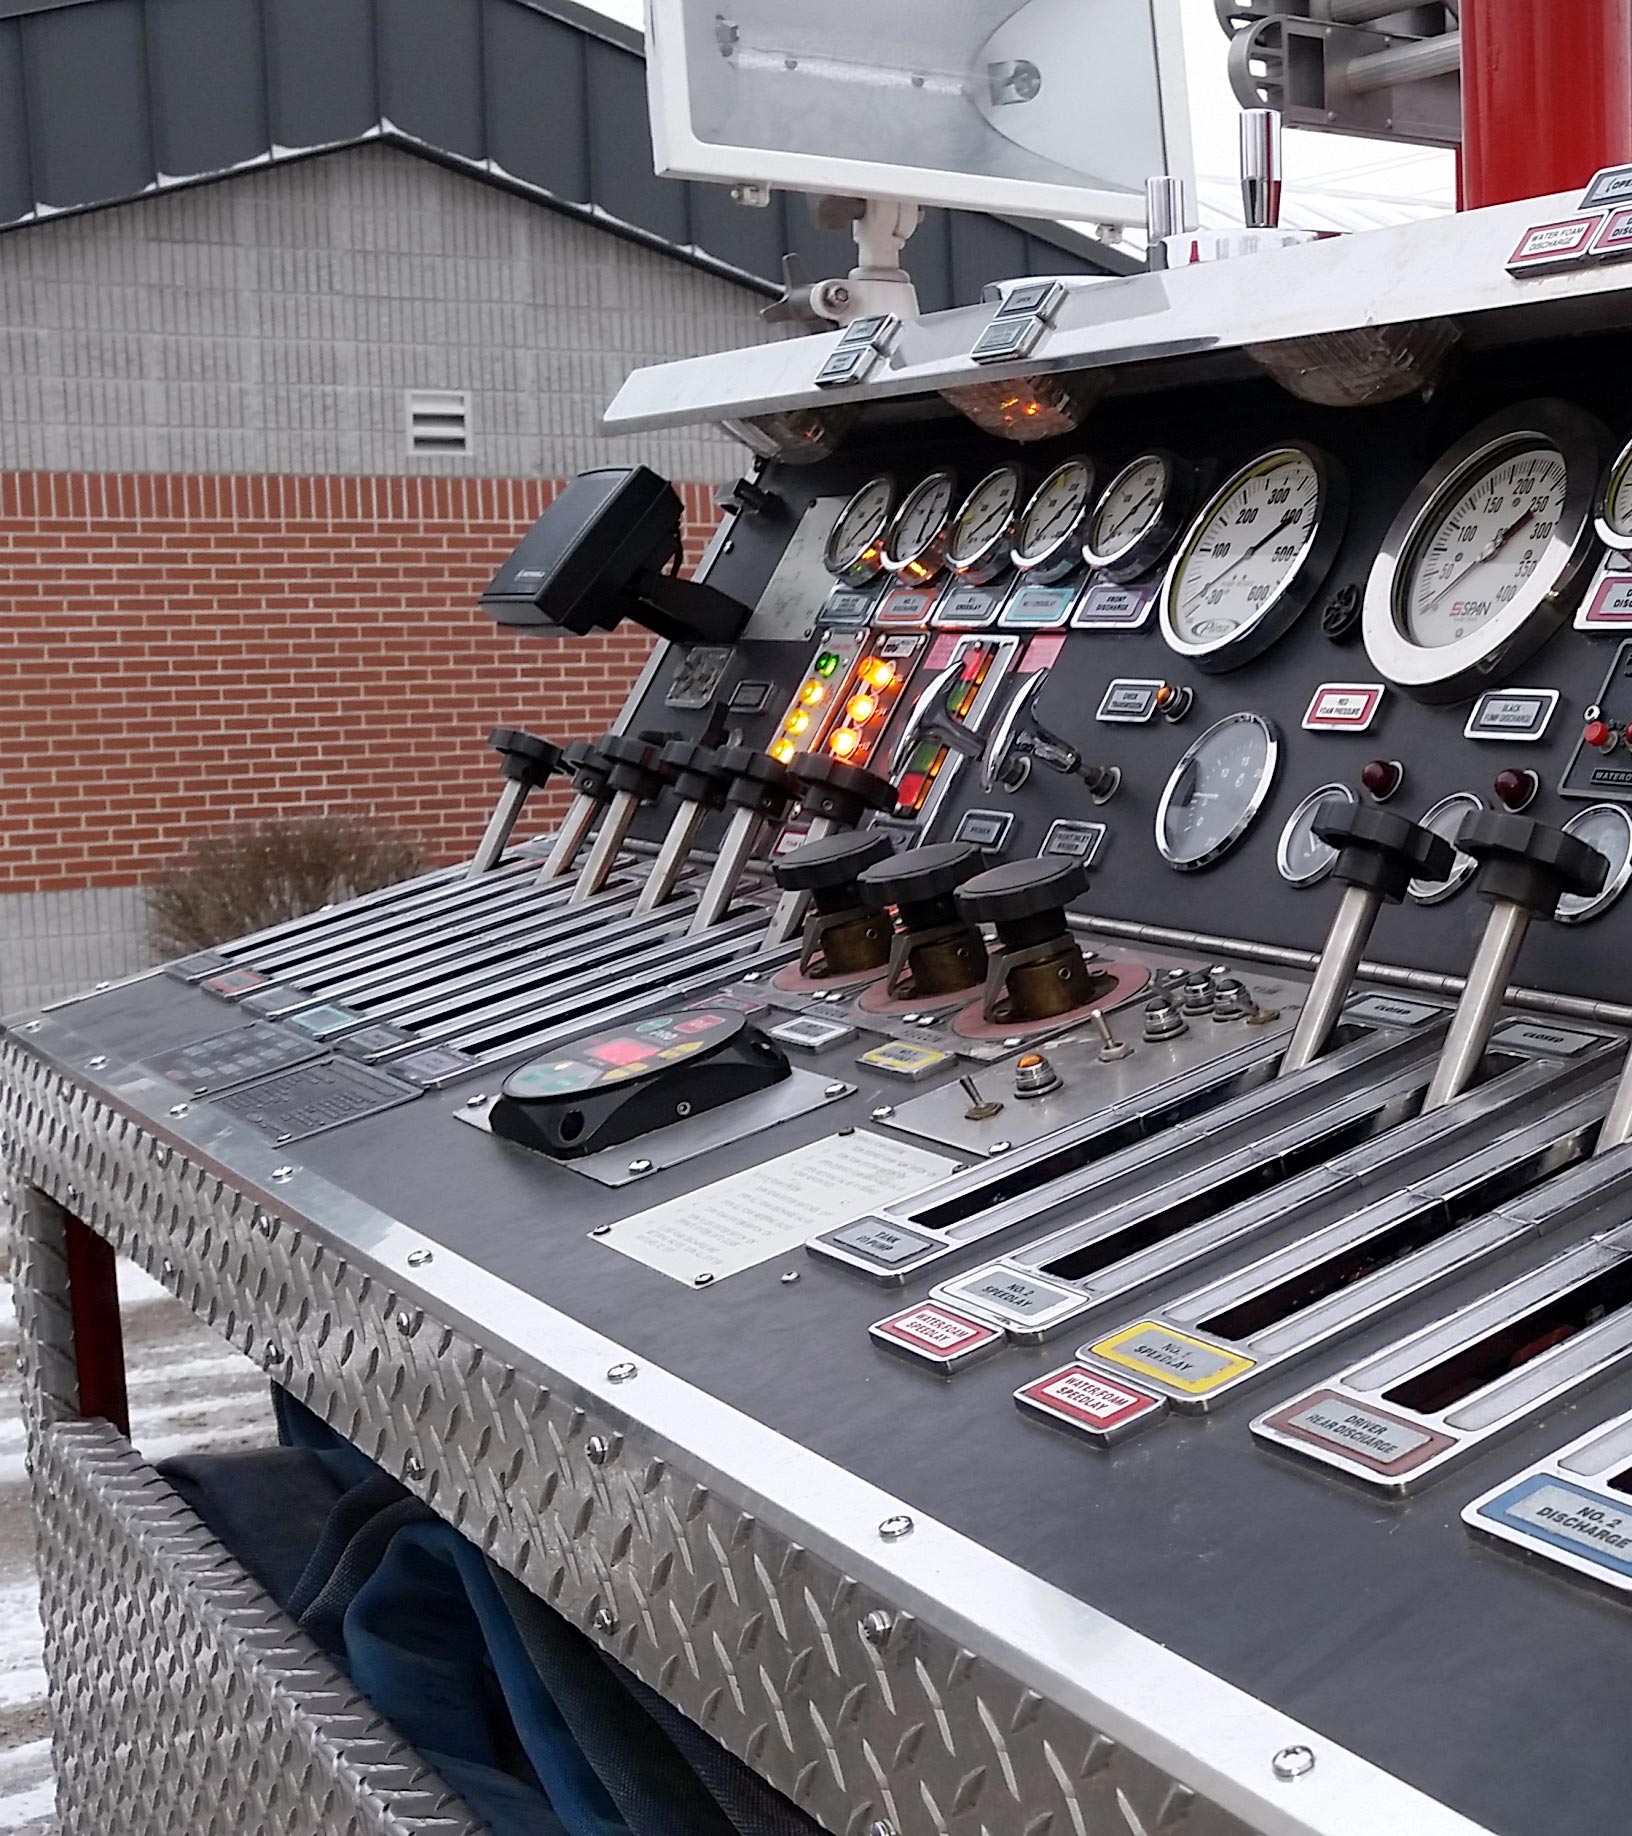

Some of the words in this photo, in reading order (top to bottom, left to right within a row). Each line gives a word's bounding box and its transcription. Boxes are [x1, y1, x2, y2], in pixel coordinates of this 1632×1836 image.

[1531, 229, 1560, 242] WATER
[1560, 226, 1585, 239] FOAM
[1528, 236, 1574, 251] DISCHARGE
[1514, 478, 1535, 495] 200
[1267, 488, 1291, 505] 300
[1529, 496, 1549, 513] 250
[1483, 497, 1504, 514] 150
[1236, 508, 1259, 524] 200
[1281, 508, 1303, 524] 400
[1457, 525, 1477, 542] 100
[1530, 522, 1552, 540] 300
[1211, 542, 1231, 558] 100
[1272, 546, 1293, 561] 500
[1438, 563, 1455, 580] 50
[1514, 561, 1536, 578] 350
[1247, 584, 1270, 601] 600
[1496, 585, 1518, 602] 400
[1374, 1004, 1411, 1015] CLOSED
[1522, 1031, 1564, 1043] CLOSED
[982, 1285, 1033, 1308] SPEEDLAY
[905, 1321, 951, 1343] SPEEDLAY
[915, 1312, 945, 1330] WATER
[944, 1323, 970, 1339] FOAM
[1134, 1345, 1194, 1372] SPEEDLAY
[1056, 1386, 1110, 1411] SPEEDLAY
[1065, 1377, 1100, 1396] WATER
[1099, 1391, 1129, 1407] FOAM
[1306, 1413, 1337, 1433] REAR
[1333, 1425, 1400, 1455] DISCHARGE
[1344, 1415, 1388, 1436] DRIVER
[1577, 1506, 1603, 1522] NO.
[1607, 1518, 1624, 1529] 2
